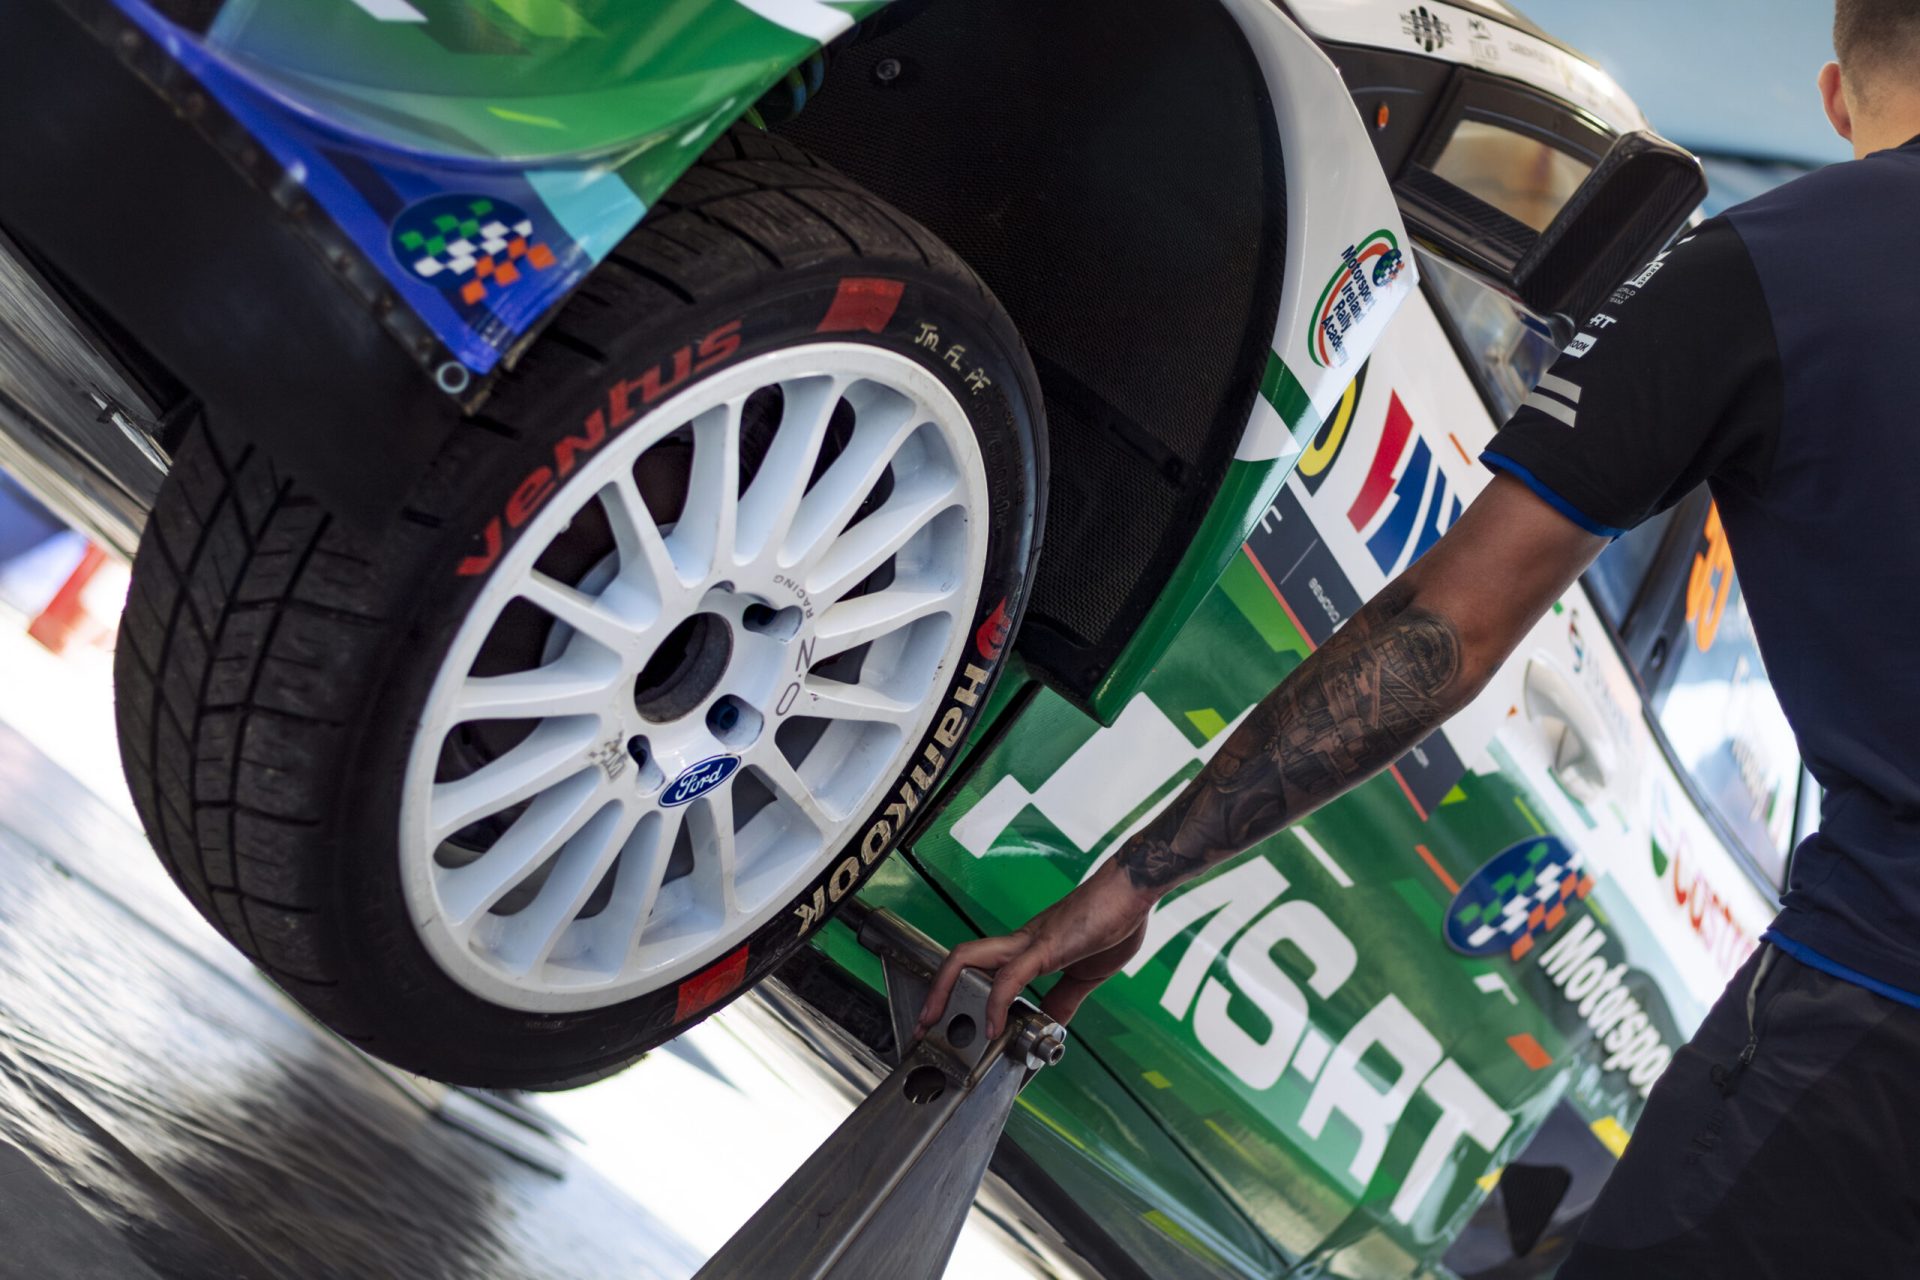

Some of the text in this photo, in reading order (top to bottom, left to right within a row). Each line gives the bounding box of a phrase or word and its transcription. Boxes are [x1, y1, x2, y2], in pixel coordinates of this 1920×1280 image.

[1341, 244, 1377, 310] Motorsport
[1333, 299, 1352, 333] Rally
[1341, 280, 1366, 324] Ireland
[772, 573, 815, 620] RACING
[675, 763, 724, 801] Ford
